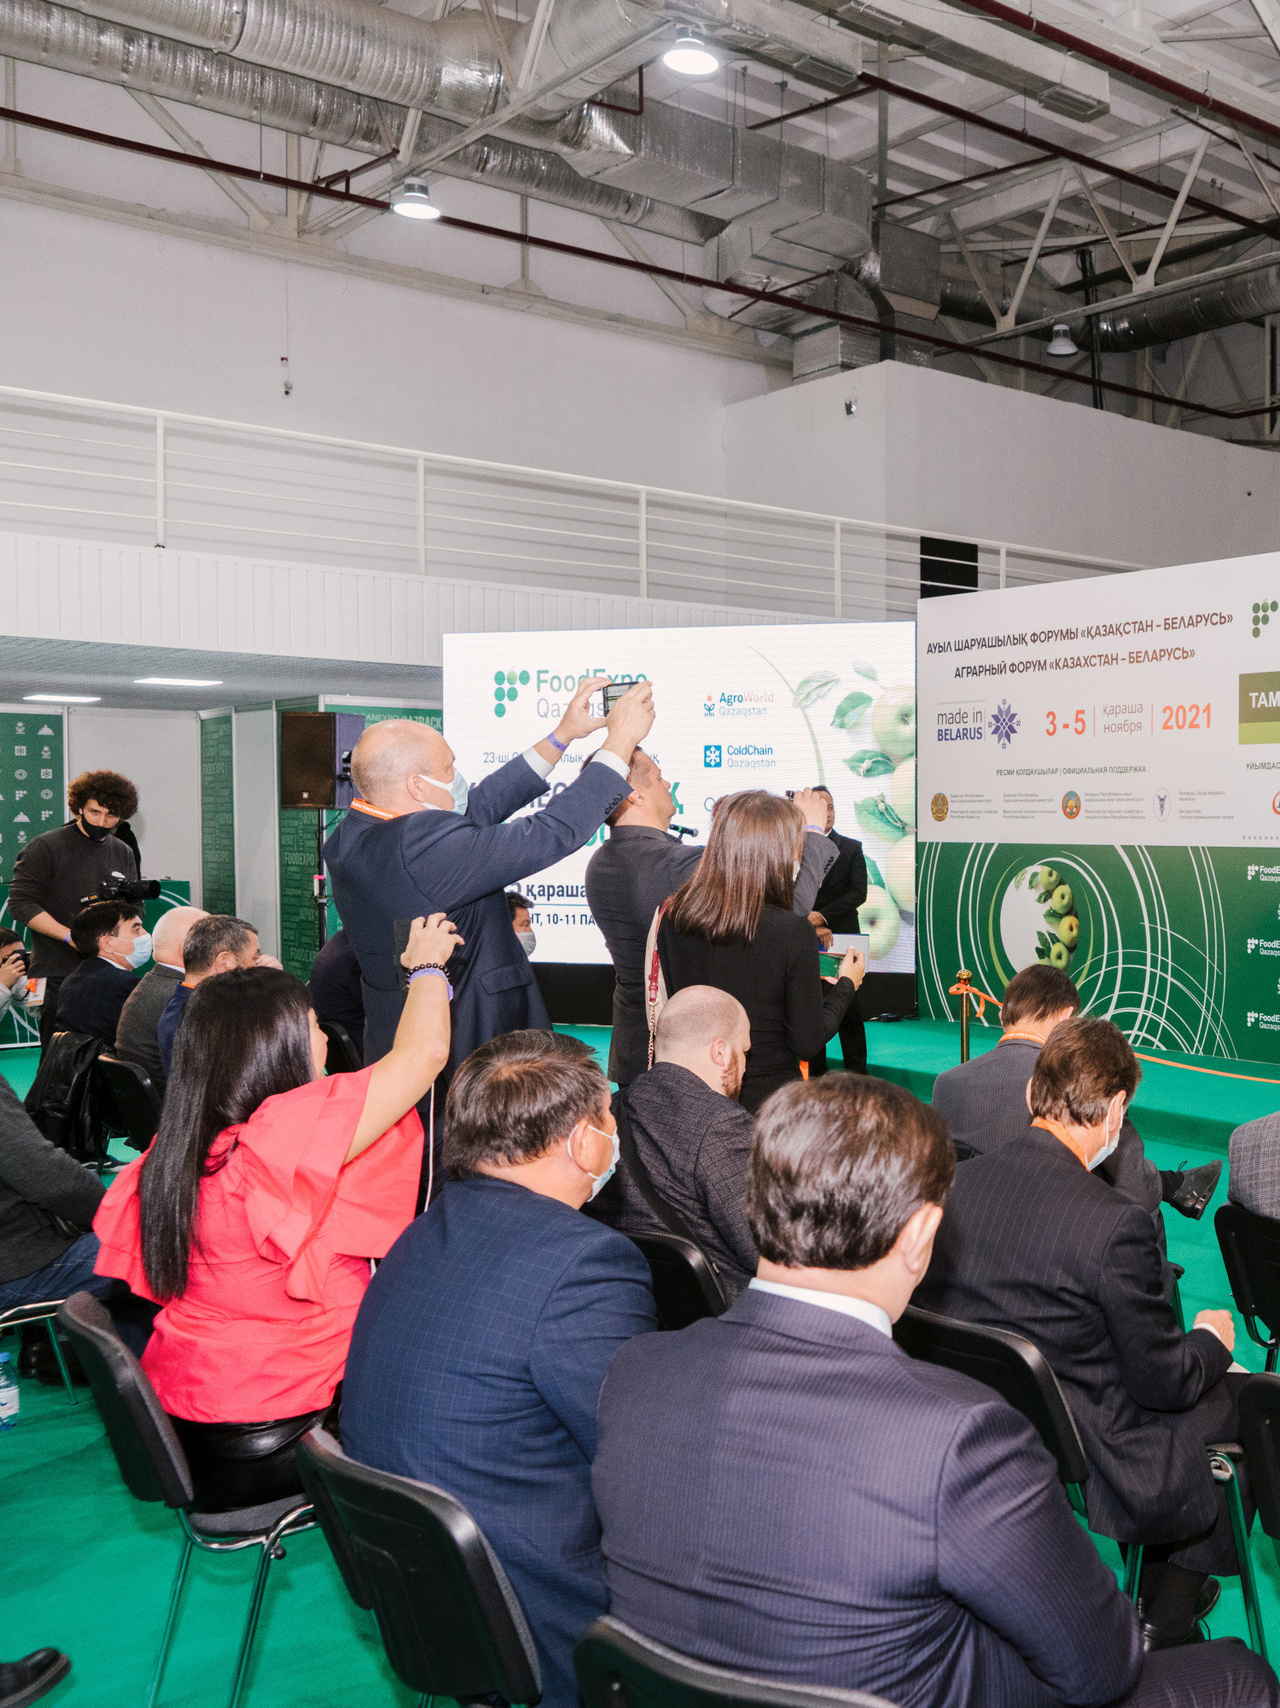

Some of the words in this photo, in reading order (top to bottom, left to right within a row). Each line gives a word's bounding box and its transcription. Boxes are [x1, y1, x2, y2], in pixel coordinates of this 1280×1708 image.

[927, 641, 952, 654] АУЫЛ
[954, 633, 1028, 652] ШАРУАШЫЛЫҚ
[1030, 628, 1078, 644] ФОРУМЫ
[1081, 620, 1153, 640] «ҚАЗАҚСТАН
[1164, 612, 1233, 630] БЕЛАРУСЬ»
[954, 661, 1006, 678] АГРАРНЫЙ
[1009, 659, 1047, 674] ФОРУМ
[1049, 653, 1118, 670] «КАЗАХСТАН
[1129, 647, 1195, 664] БЕЛАРУСЬ»
[720, 692, 773, 706] AgroWorld
[719, 706, 766, 717] Qazaqstan
[938, 708, 968, 725] made
[973, 708, 982, 723] in
[1103, 704, 1143, 718] қараша
[1162, 703, 1210, 730] 2021
[938, 727, 982, 741] BELARUS
[1104, 719, 1142, 735] ноября
[727, 745, 773, 755] ColdChain
[727, 758, 776, 769] Qazaqstan
[1063, 767, 1107, 775] ОФИЦИАЛЬНАЯ
[547, 914, 575, 924] 10-11
